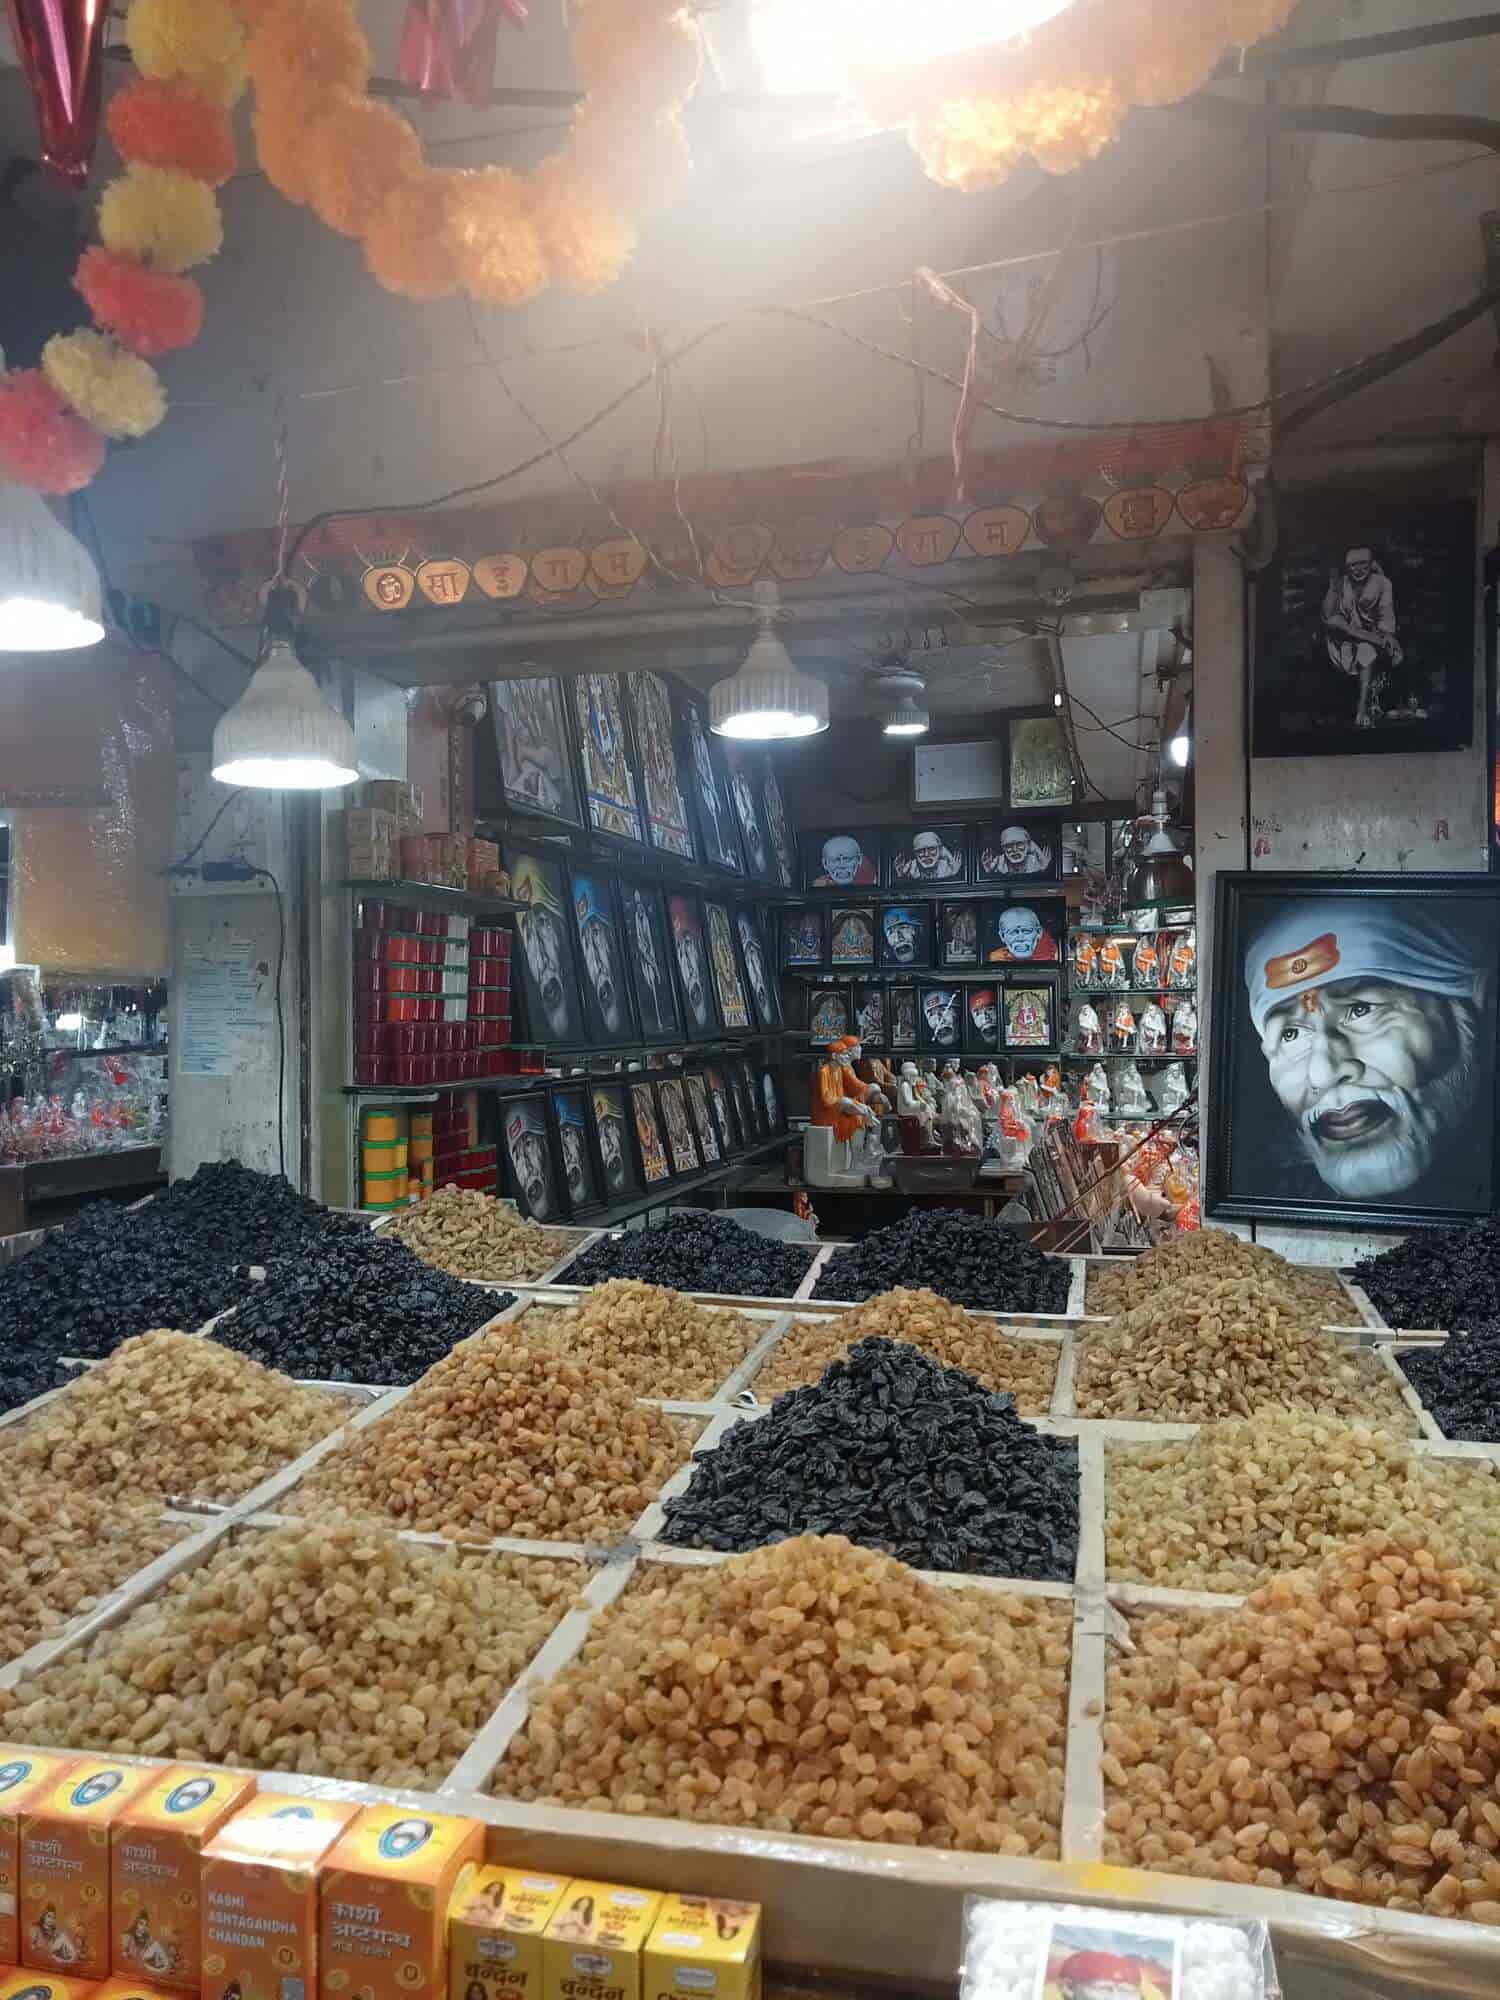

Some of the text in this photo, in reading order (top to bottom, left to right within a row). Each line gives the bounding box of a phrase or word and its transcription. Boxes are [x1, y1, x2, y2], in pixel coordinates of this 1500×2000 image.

[208, 1889, 245, 1908] KASHI
[208, 1910, 298, 1936] ASHTAGANDHA
[208, 1928, 265, 1949] CHANDAN
